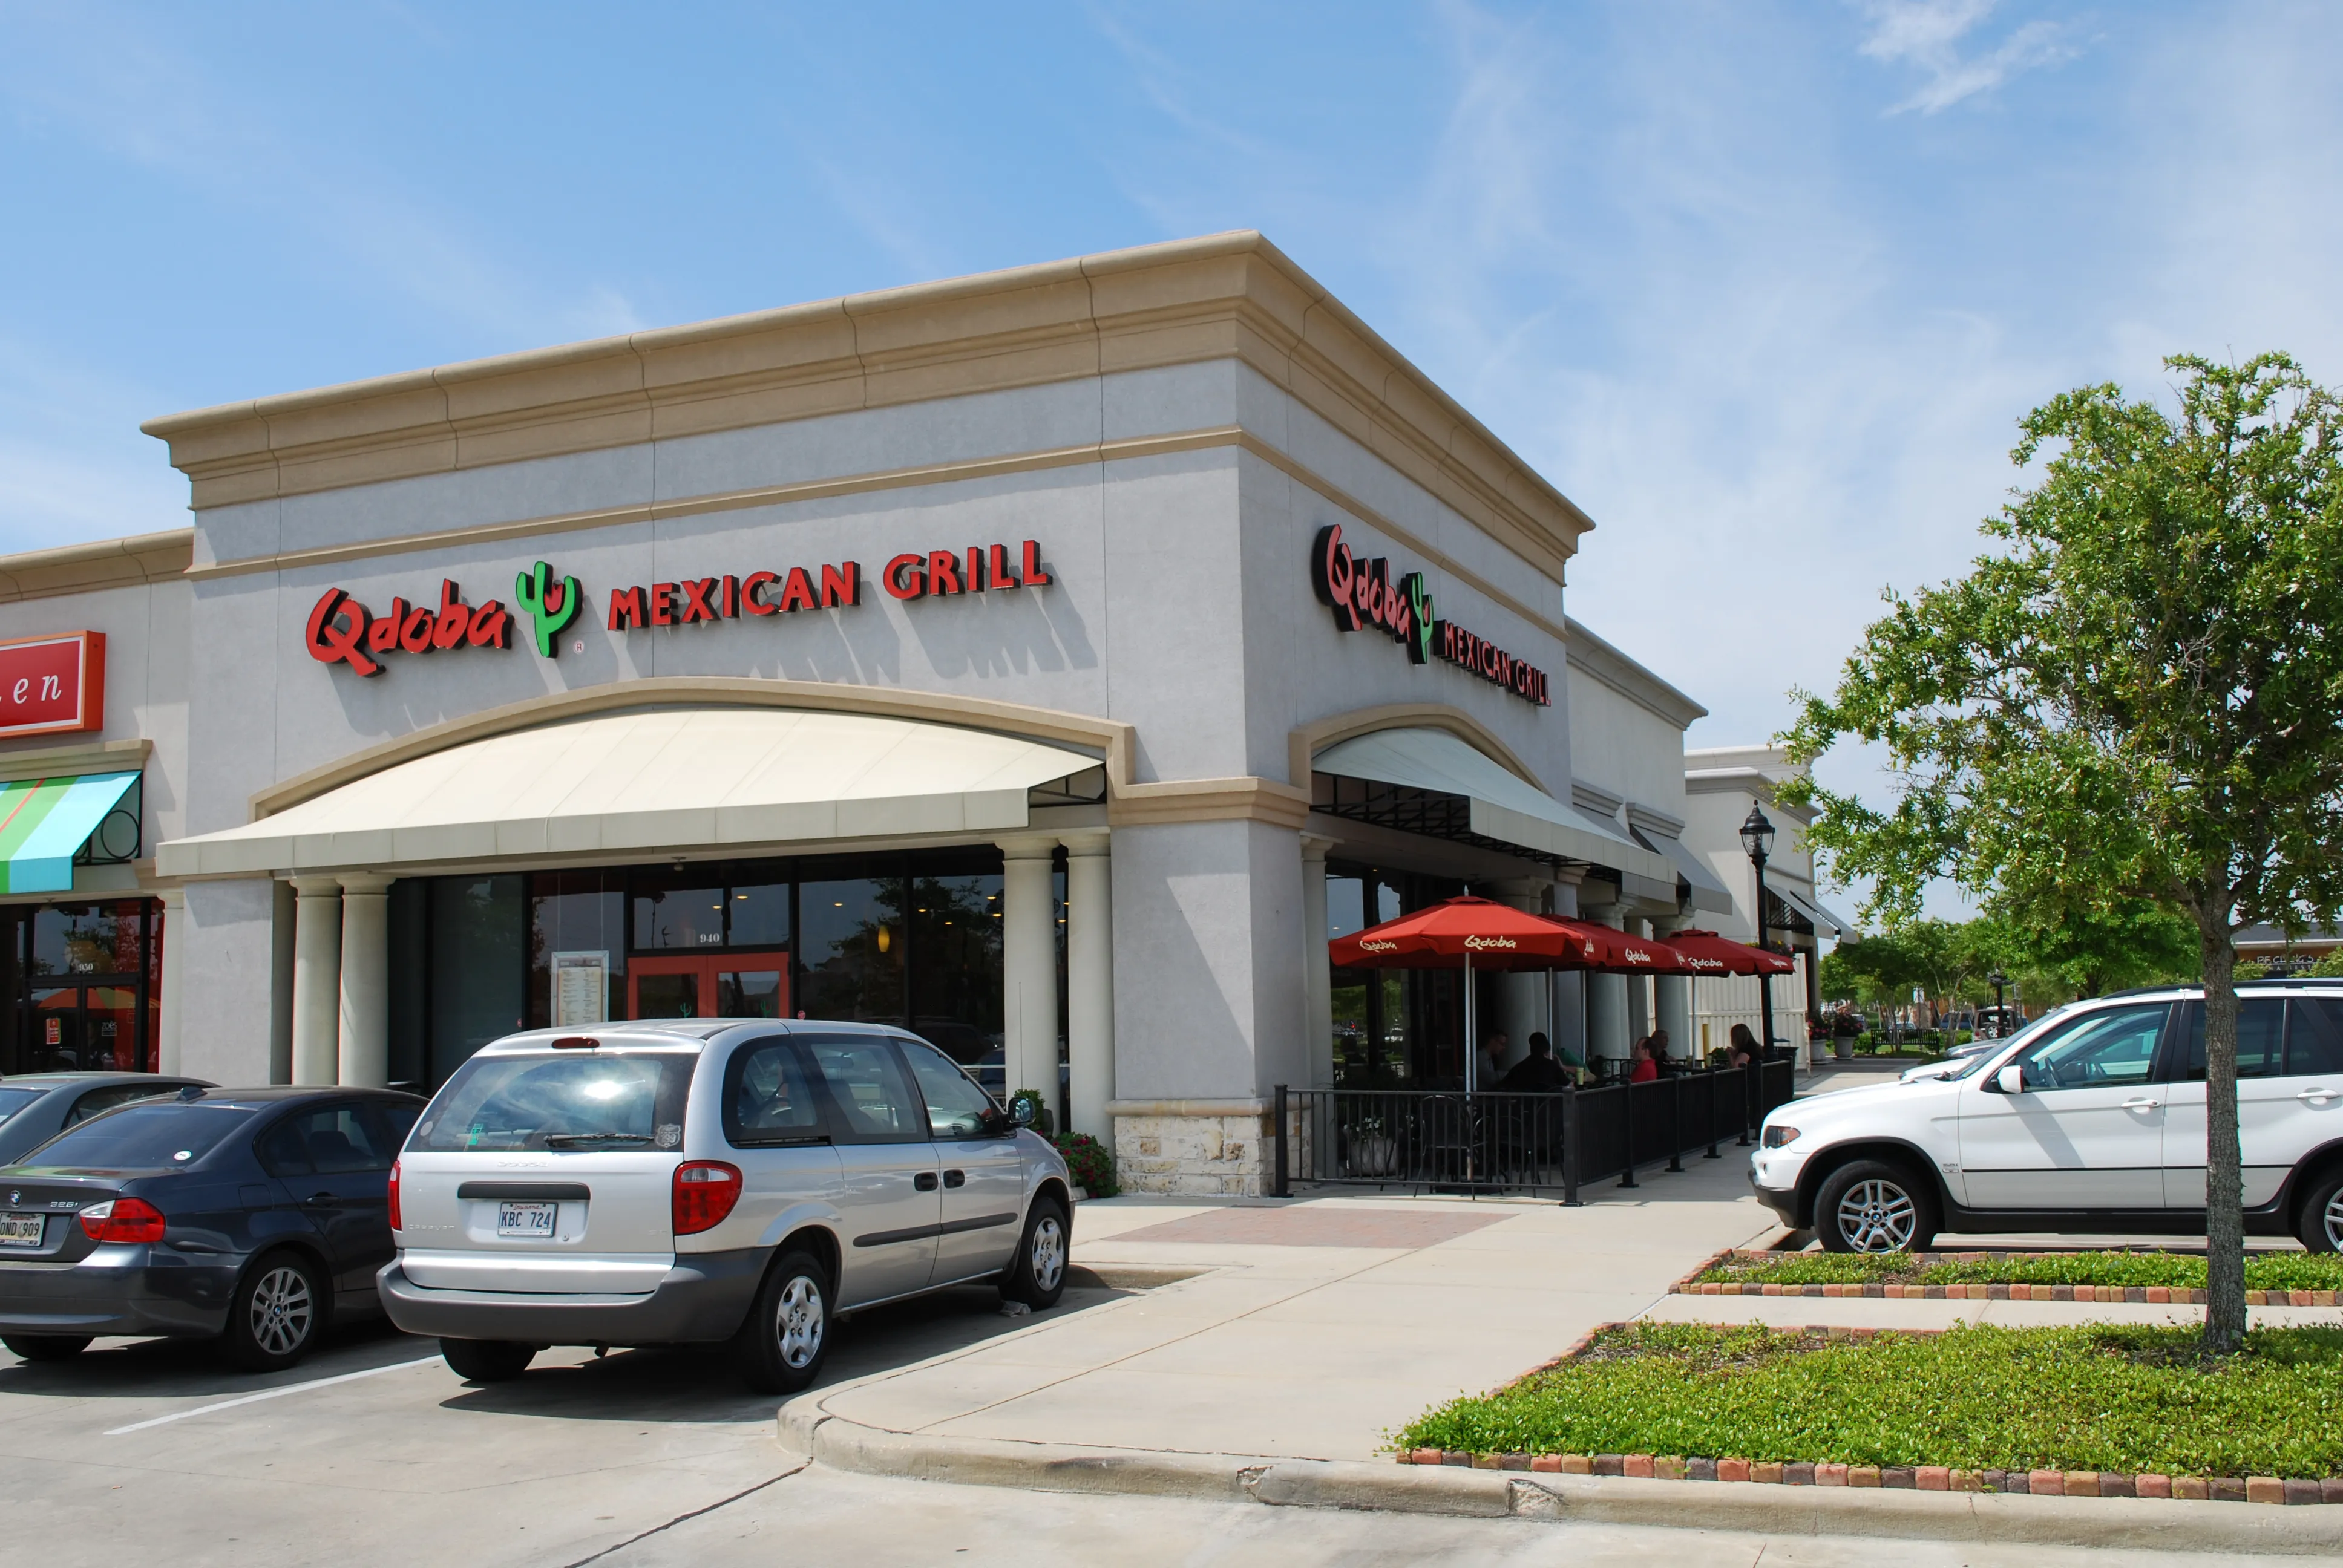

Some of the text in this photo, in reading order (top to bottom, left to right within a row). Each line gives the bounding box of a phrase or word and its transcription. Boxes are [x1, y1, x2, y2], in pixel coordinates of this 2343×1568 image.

[306, 540, 1053, 677] Qdoba MEXICAN GRILL
[1325, 524, 1552, 707] Qdoba MEXICAN GRILL
[0, 674, 62, 704] en
[700, 933, 720, 944] 940
[1359, 939, 1398, 953] Qdoba
[1464, 935, 1517, 950] Qdoba
[1625, 947, 1651, 964] Qdoba
[1687, 956, 1723, 969] Qdoba
[500, 1211, 551, 1227] KBC 724
[22, 1222, 40, 1236] 909
